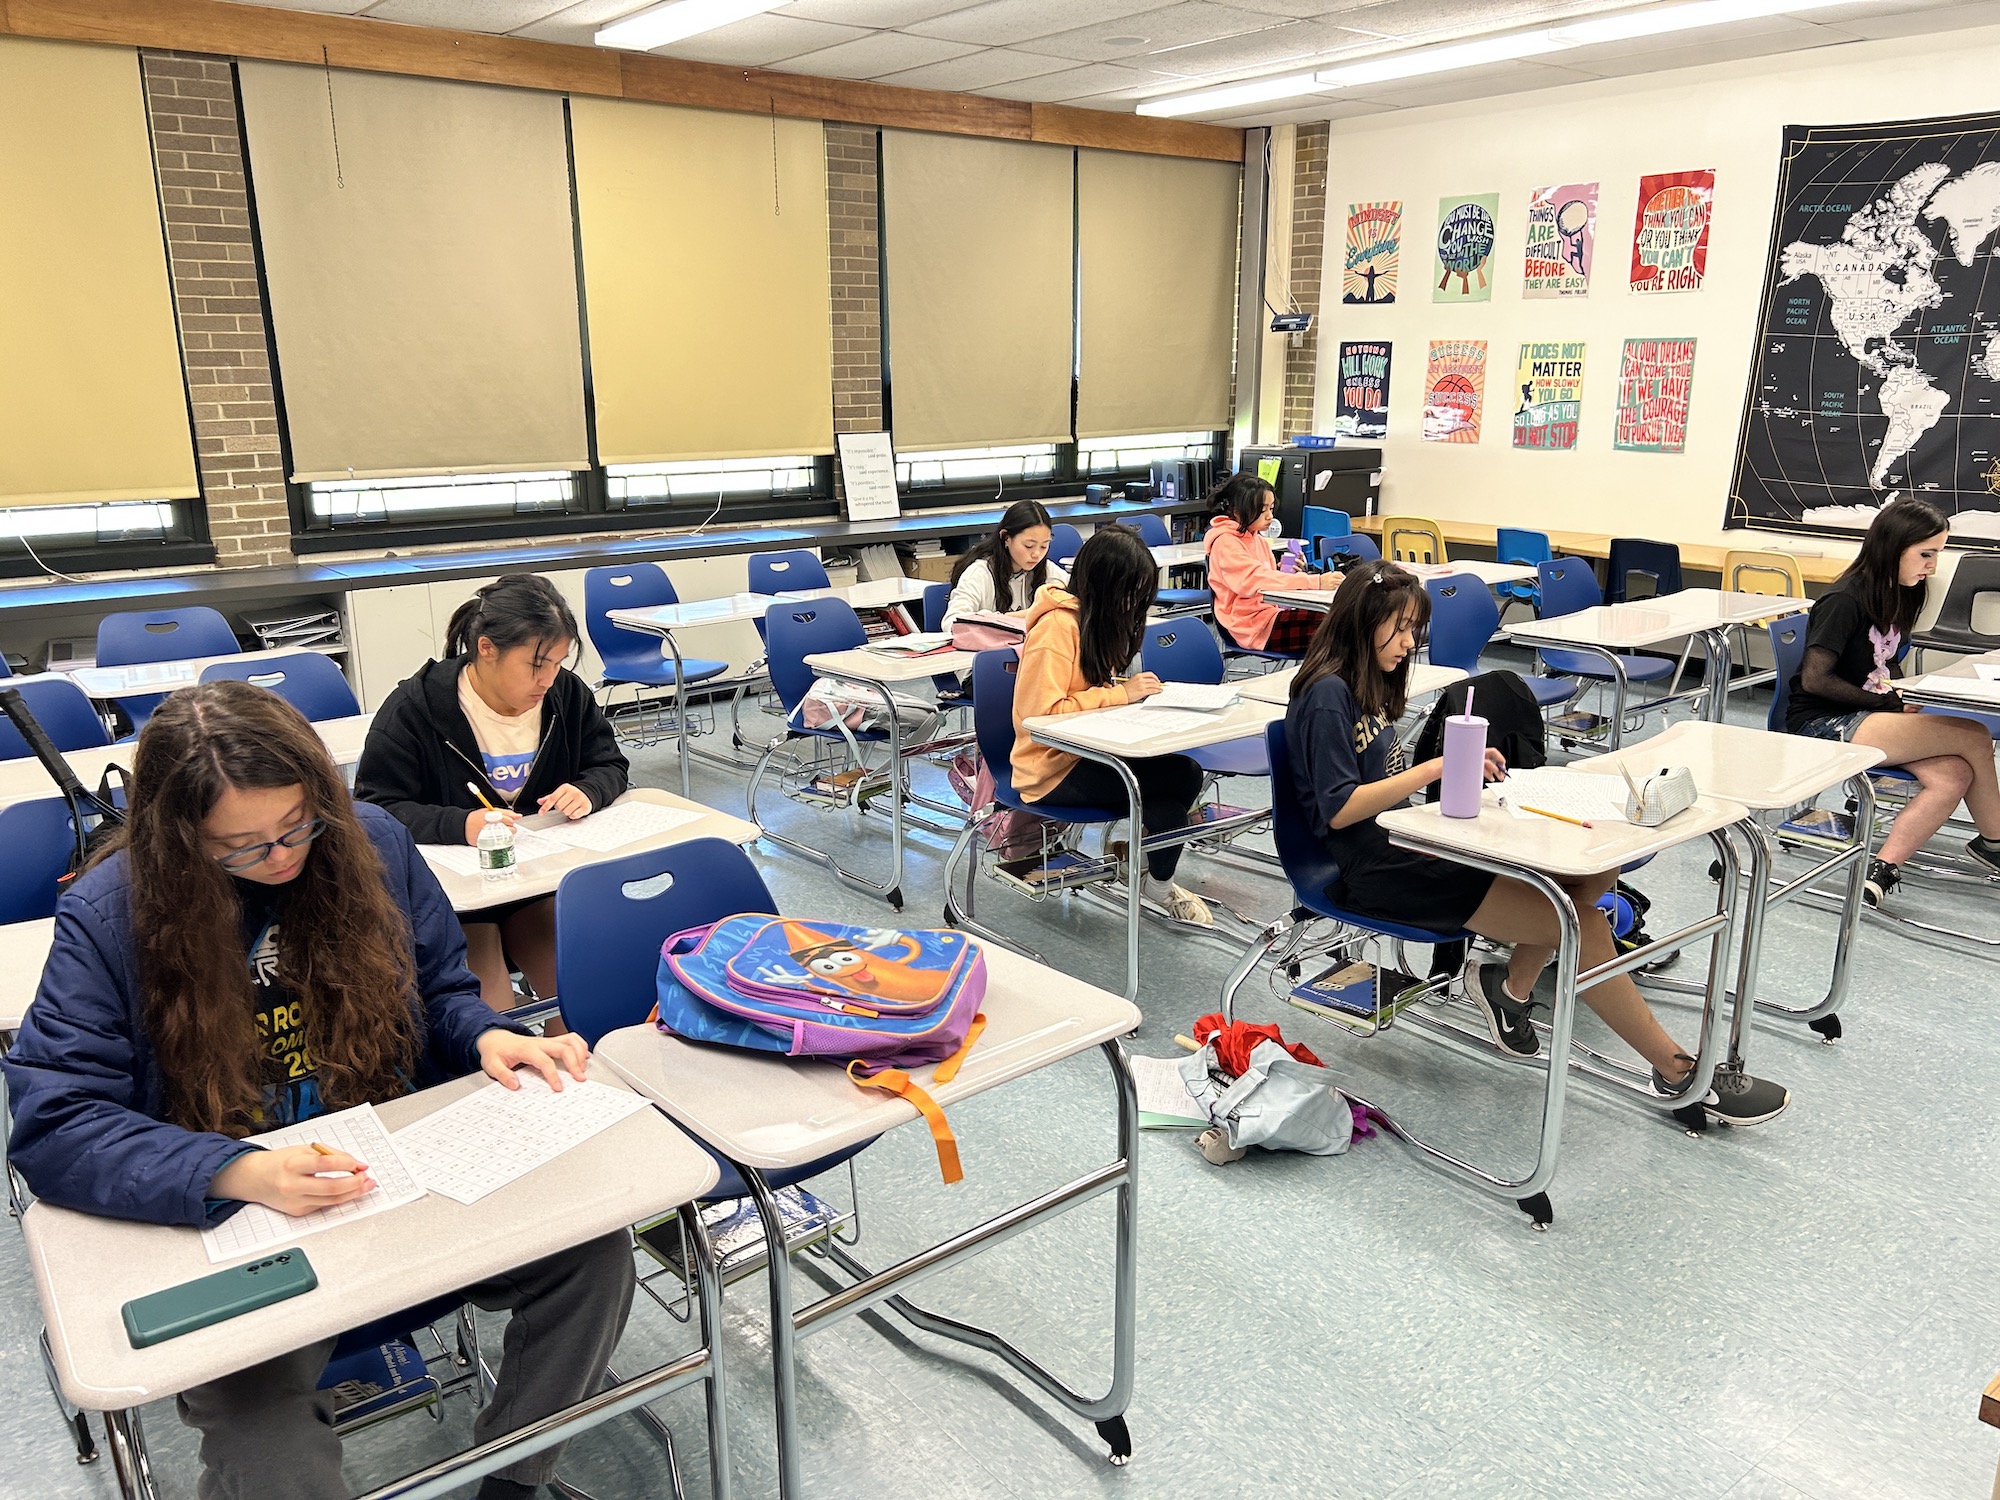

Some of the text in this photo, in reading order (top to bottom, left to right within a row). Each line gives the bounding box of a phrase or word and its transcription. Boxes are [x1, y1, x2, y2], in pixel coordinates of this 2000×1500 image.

[1456, 205, 1472, 221] MUST
[1472, 206, 1480, 220] BE
[1481, 209, 1492, 223] THE
[1530, 207, 1554, 223] THINGS
[1645, 204, 1705, 229] THINK YOU CAN
[1799, 204, 1851, 213] ARCTIC OCEAN
[1348, 208, 1400, 229] MINDSET
[1368, 228, 1378, 239] IS
[1439, 221, 1494, 249] CHANGE
[1528, 224, 1555, 245] ARE
[1641, 228, 1702, 249] OR YOU THINK
[1445, 235, 1489, 255] YOU WISH
[1463, 243, 1488, 259] THE
[1526, 241, 1561, 261] DIFFICULT
[1642, 245, 1695, 269] YOU CAN'T
[1525, 259, 1566, 278] BEFORE
[1835, 263, 1883, 272] CANADA
[1525, 277, 1586, 290] THEY ARE EASY
[1631, 266, 1703, 292] YOU'RE RIGHT
[1786, 308, 1809, 316] PACIFIC
[1930, 324, 1967, 333] ATLANTIC
[1934, 336, 1960, 344] OCEAN
[1346, 345, 1386, 356] NOTHING
[1430, 343, 1485, 362] SUCCESS
[1519, 342, 1585, 370] IT DOES NOT
[1625, 341, 1695, 364] ALL OUR DREAMS
[1341, 354, 1389, 380] WILL WORK
[1533, 362, 1582, 377] MATTER
[1624, 358, 1692, 379] CAN COME TRUE
[1346, 377, 1381, 389] UNLESS
[1536, 379, 1581, 388] HOW SLOWLY
[1622, 378, 1690, 406] IF WE HAVE
[1344, 387, 1382, 411] YOU DO
[1428, 391, 1478, 410] SUCCESS
[1539, 388, 1573, 403] YOU GO
[1821, 401, 1844, 409] PACIFIC
[1515, 404, 1578, 427] SO LONG AS YOU
[1619, 398, 1687, 425] THE COURAGE
[1514, 421, 1578, 448] DO NOT STOP
[1618, 424, 1629, 442] TO
[1631, 421, 1661, 444] PURSUE
